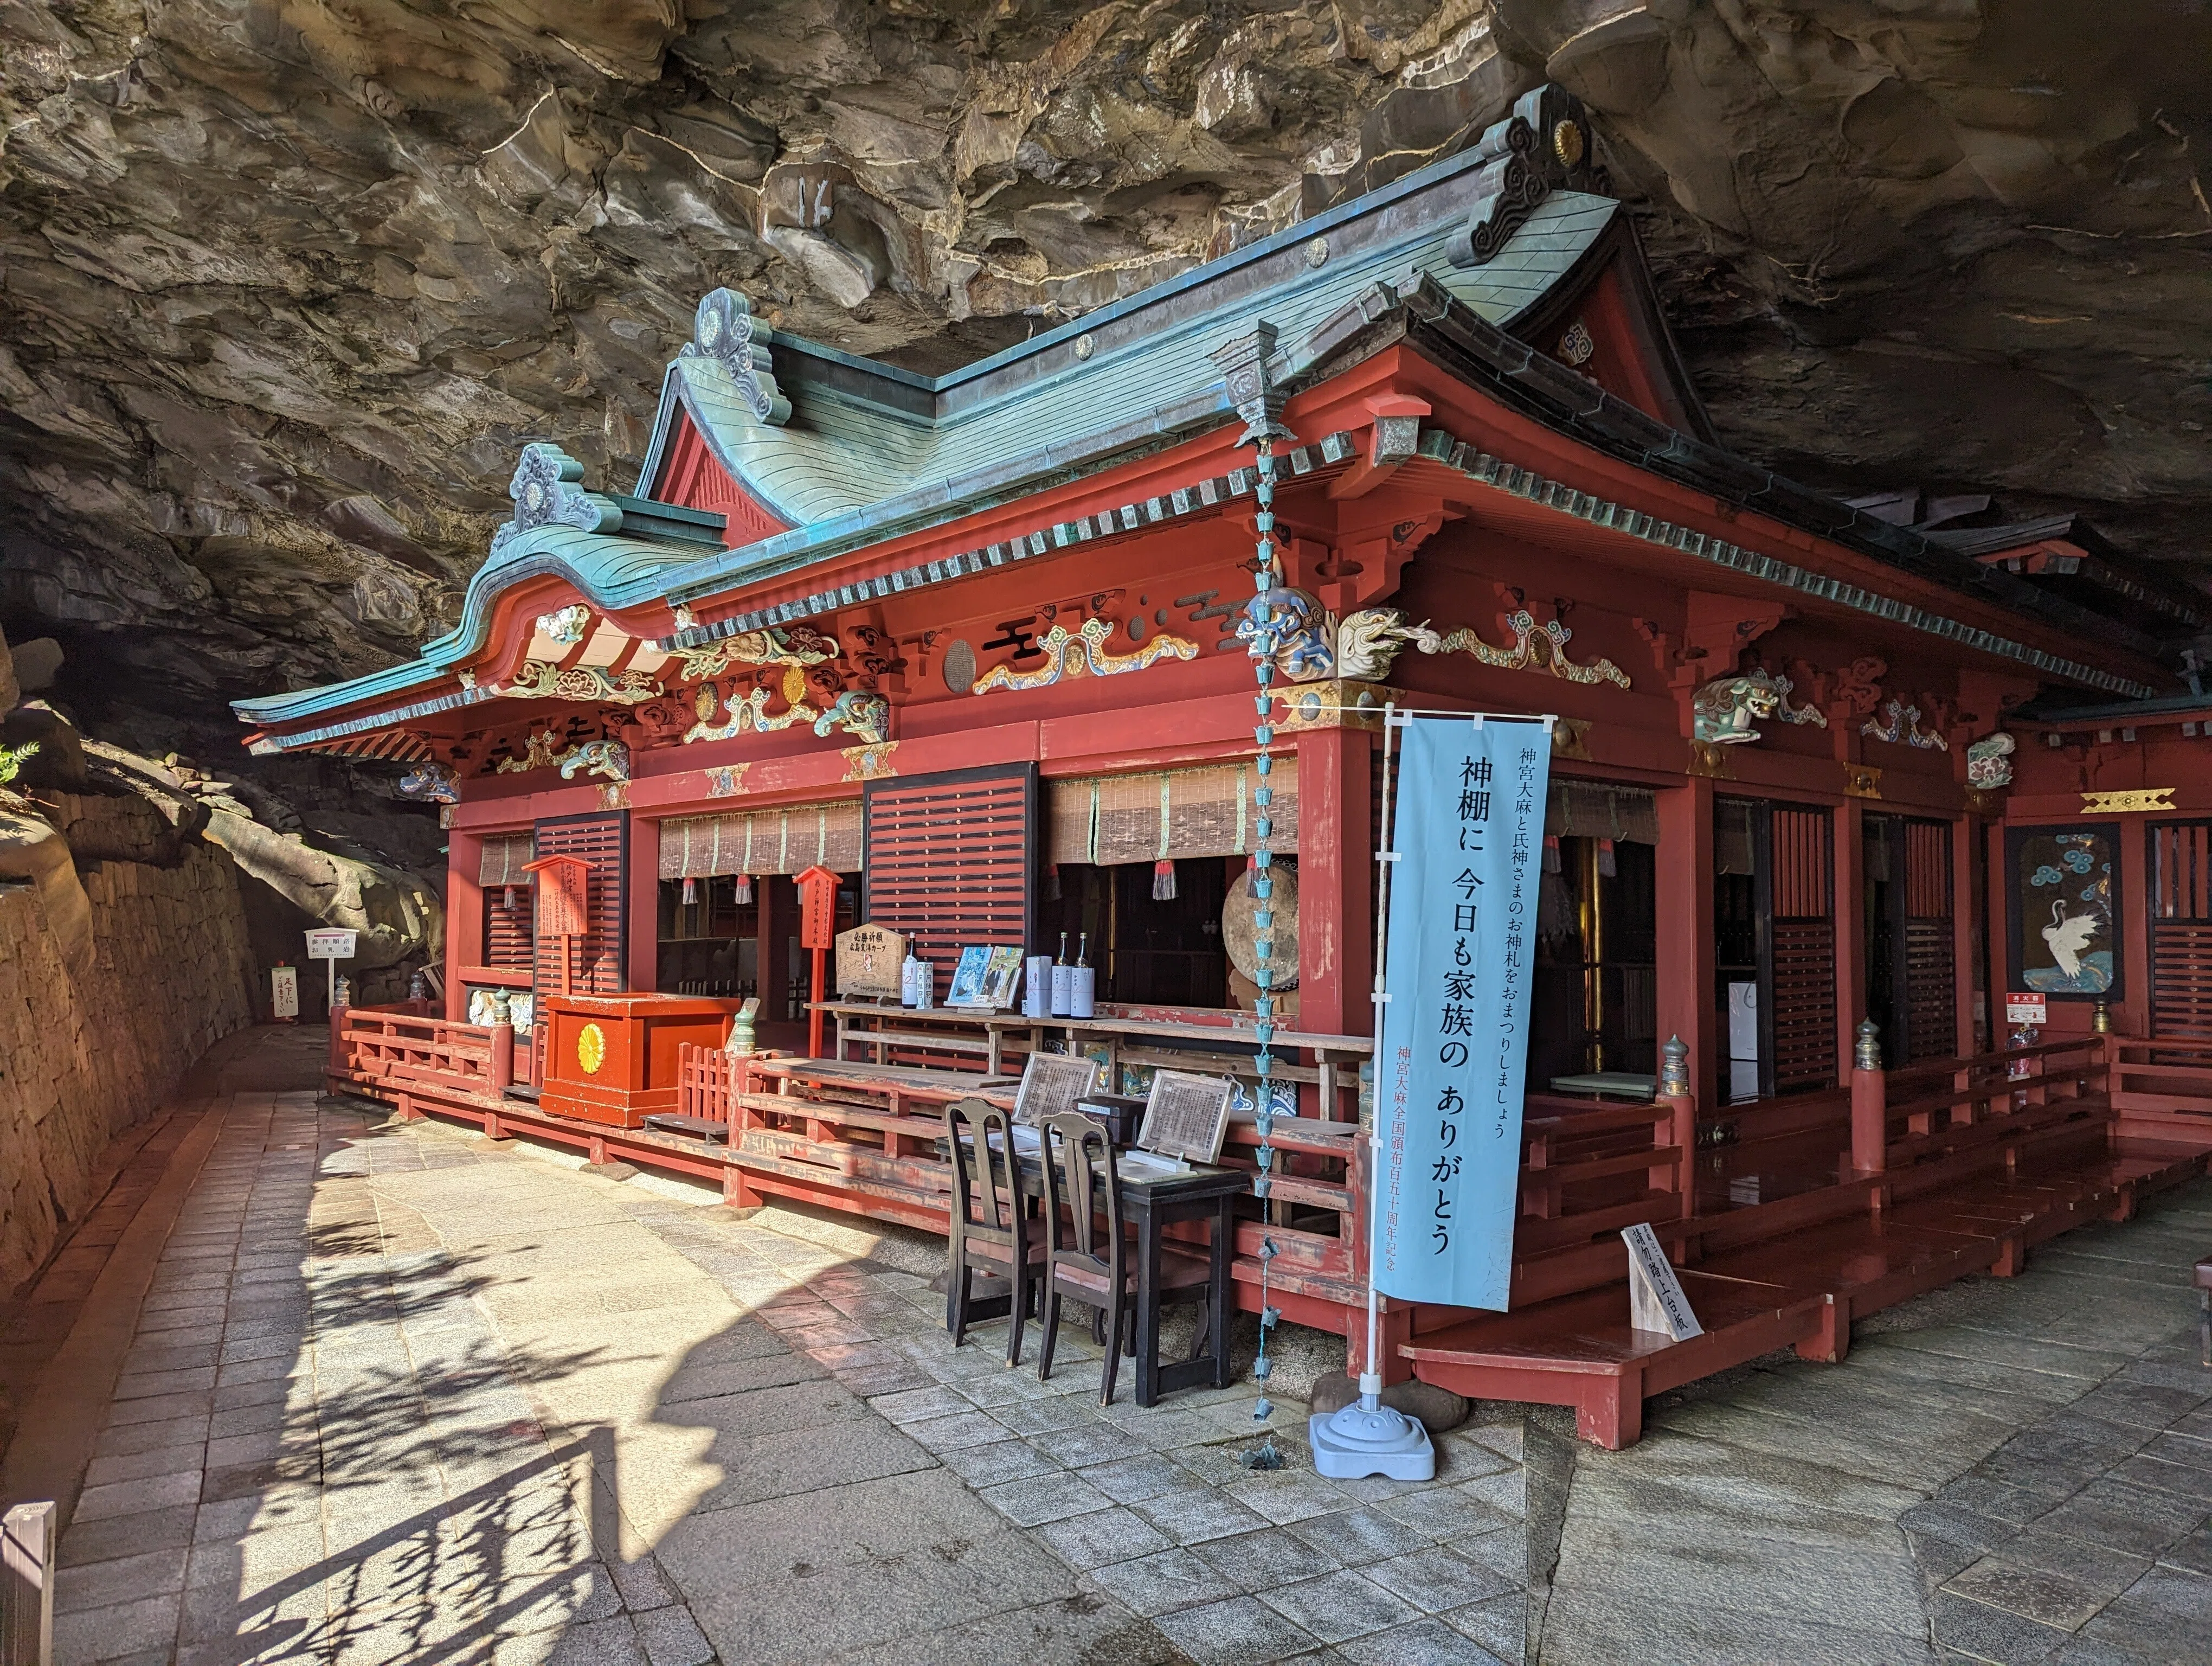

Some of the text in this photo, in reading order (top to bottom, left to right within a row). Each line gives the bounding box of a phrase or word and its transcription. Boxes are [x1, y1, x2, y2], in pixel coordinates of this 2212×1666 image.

[284, 977, 293, 1004] 足下に
[850, 943, 886, 952] 広島東洋カープ
[854, 931, 883, 944] 必勝祈願
[1495, 748, 1536, 1139] 神宮大麻と氏神さまのお神札をおまつりしましょう
[1432, 755, 1493, 1256] 神棚に 今日も家族の ありがとう
[1386, 1046, 1411, 1272] 神宮大麻全国頒布百五十周年記念
